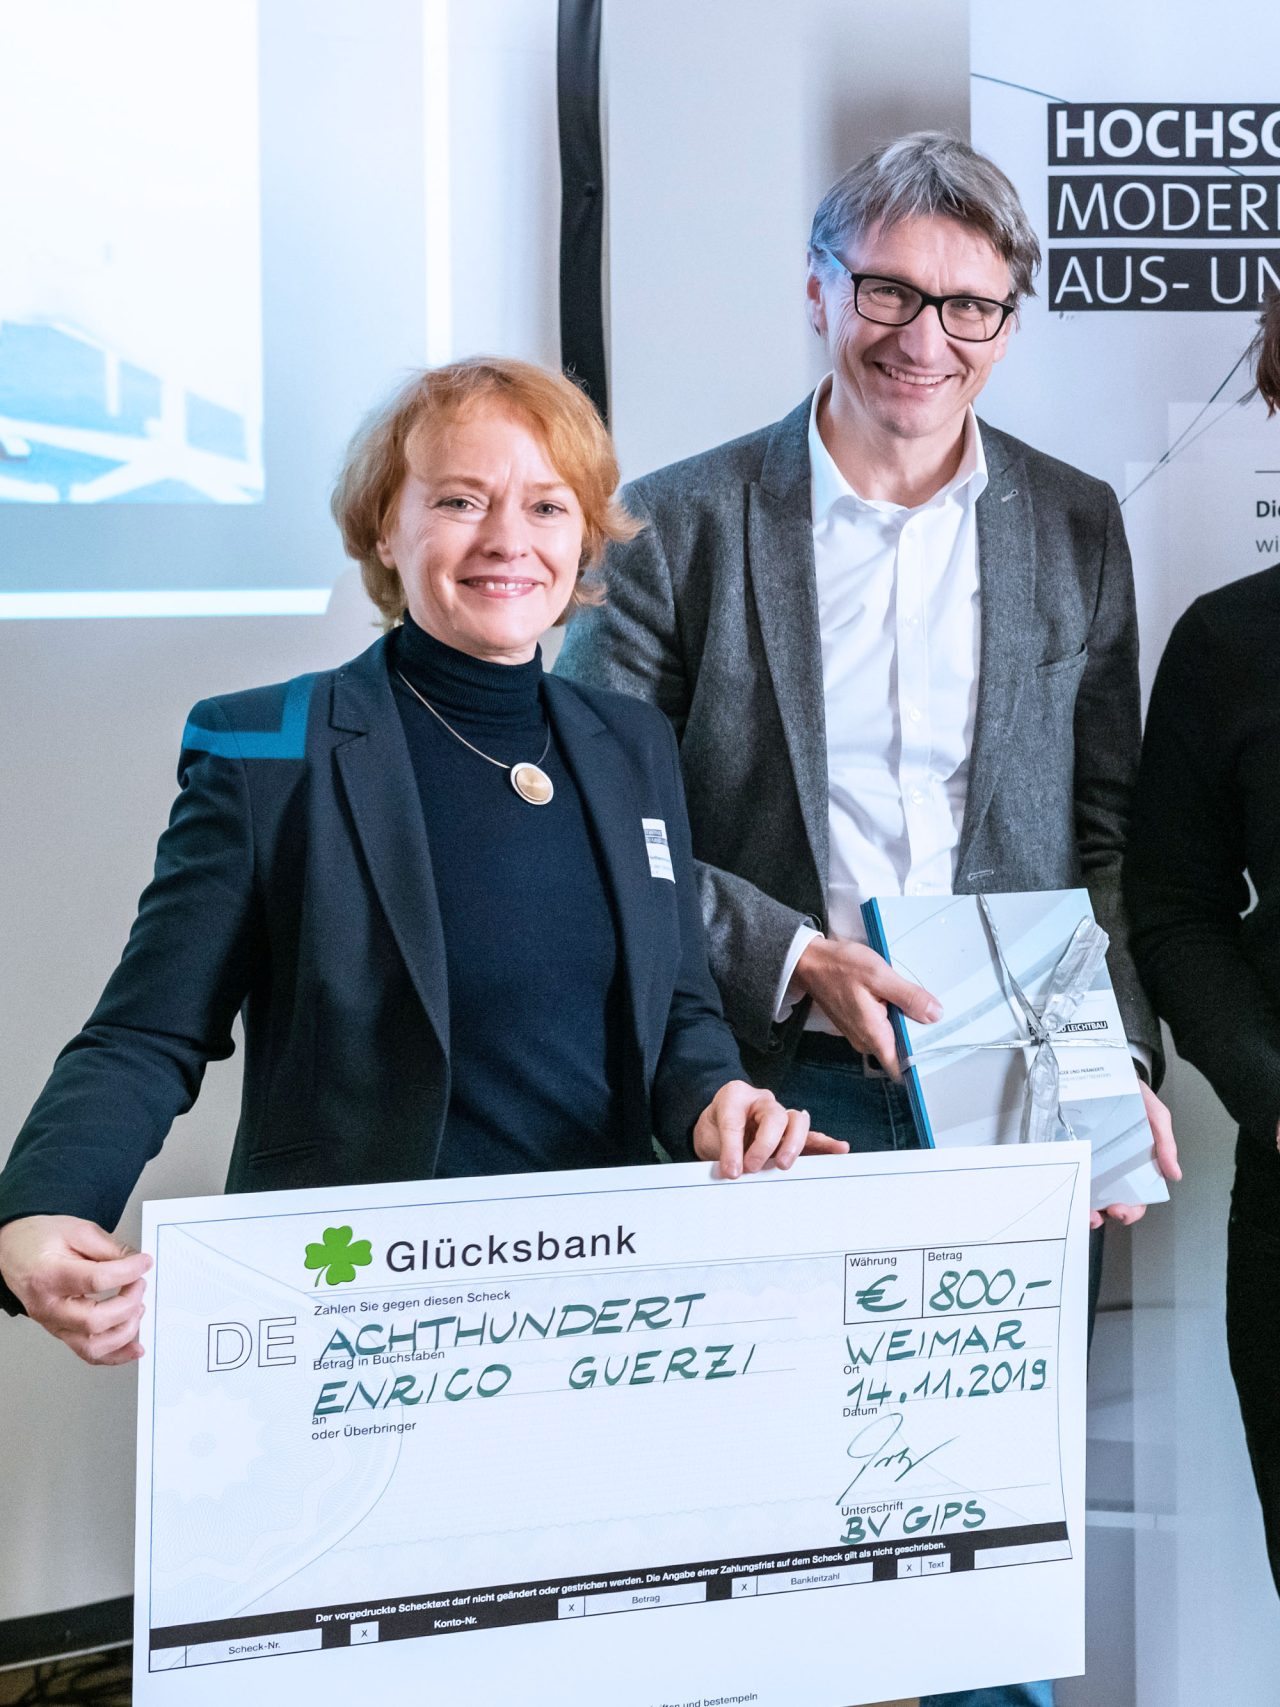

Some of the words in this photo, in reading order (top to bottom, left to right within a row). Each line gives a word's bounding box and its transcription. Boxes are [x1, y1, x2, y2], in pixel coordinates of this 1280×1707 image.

[1055, 256, 1190, 304] AUS-
[1067, 1021, 1107, 1032] LEICHTBAU
[386, 1226, 637, 1272] Glücksbank
[928, 1251, 963, 1262] Betrag
[850, 1256, 898, 1268] Währung
[855, 1274, 907, 1312] €
[314, 1303, 356, 1316] Zahlen
[360, 1301, 379, 1312] Sie
[382, 1299, 420, 1312] gegen
[424, 1294, 464, 1307] diesen
[467, 1290, 511, 1303] Scheck
[319, 1293, 706, 1366] ACHTHUNDERT
[207, 1316, 297, 1373] DE
[846, 1320, 1026, 1365] WEIMAR
[313, 1357, 354, 1371] Betrag
[358, 1356, 369, 1367] in
[372, 1350, 445, 1366] Buchstaben
[843, 1365, 860, 1375] Ort
[313, 1364, 512, 1417] ENRICO
[569, 1344, 756, 1389] GUERZI
[847, 1358, 1047, 1411] 14.11.2019
[312, 1416, 327, 1425] an
[843, 1407, 878, 1417] Datum
[312, 1428, 340, 1440] oder
[344, 1421, 417, 1438] Überbringer
[841, 1501, 904, 1517] Unterschrift
[840, 1513, 890, 1545] BV
[902, 1500, 986, 1535] GIPS
[928, 1560, 945, 1570] Text
[316, 1613, 333, 1623] Der
[335, 1605, 396, 1621] vorgedruckte
[398, 1598, 450, 1613] Schecktext
[452, 1595, 471, 1607] darf
[473, 1593, 495, 1604] nicht
[497, 1588, 537, 1602] geändert
[539, 1584, 560, 1595] oder
[561, 1579, 607, 1594] gestrichen
[609, 1576, 644, 1588] werden.
[646, 1572, 660, 1583] Die
[662, 1568, 696, 1584] Angabe
[697, 1566, 719, 1578] einer
[720, 1560, 775, 1577] Zahlungsfrist
[776, 1558, 790, 1568] auf
[792, 1555, 810, 1567] dem
[812, 1551, 843, 1564] Scheck
[844, 1550, 857, 1563] gilt
[859, 1548, 871, 1559] als
[872, 1545, 893, 1557] nicht
[894, 1540, 946, 1557] geschrieben.
[791, 1572, 841, 1586] Bankleitzahl
[632, 1594, 661, 1605] Betrag
[433, 1616, 477, 1629] Konto-Nr.
[228, 1640, 281, 1655] Scheck-Nr.
[703, 1692, 758, 1707] bestempeln
